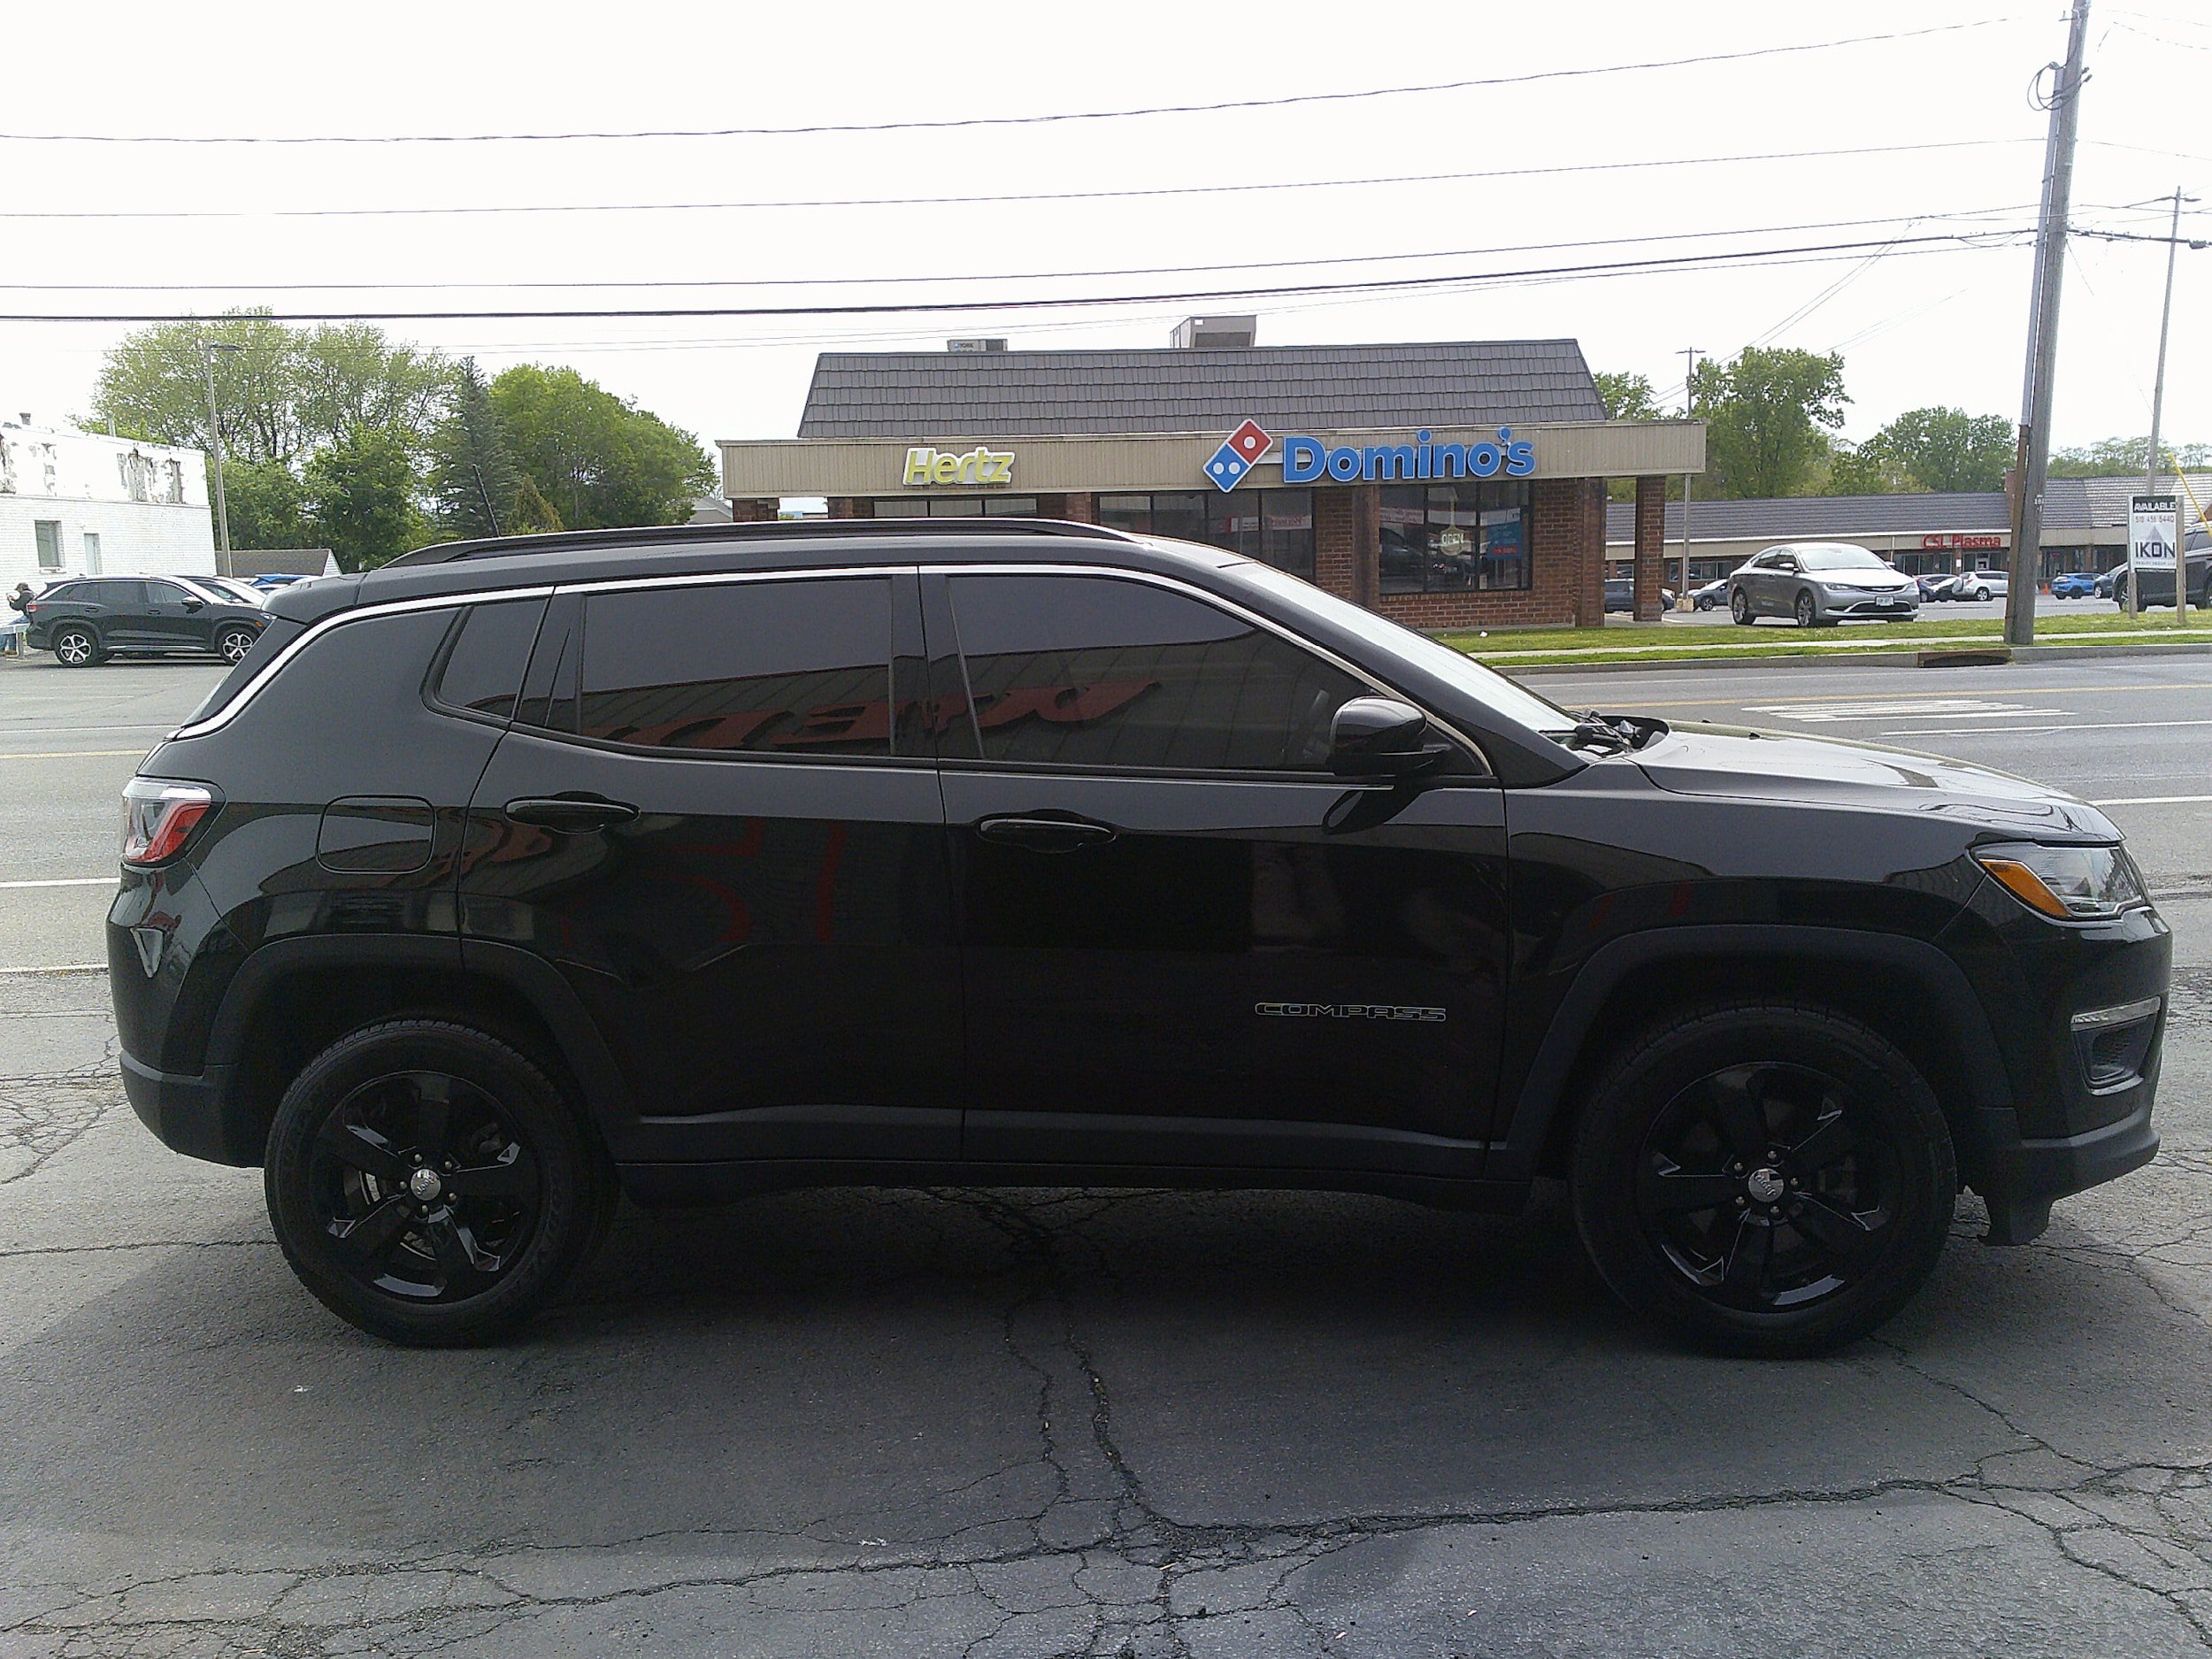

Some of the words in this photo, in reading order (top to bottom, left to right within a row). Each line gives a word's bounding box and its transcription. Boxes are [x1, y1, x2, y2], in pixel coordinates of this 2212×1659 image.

[1283, 426, 1536, 483] Domino's
[905, 449, 1014, 484] Hertz
[2134, 502, 2177, 511] AVAILABLE
[1441, 534, 1464, 544] OPEN
[1924, 534, 1947, 550] CSL
[1952, 534, 2001, 549] Plasma
[2135, 541, 2176, 558] IKON
[1255, 1002, 1447, 1022] COMPASS
